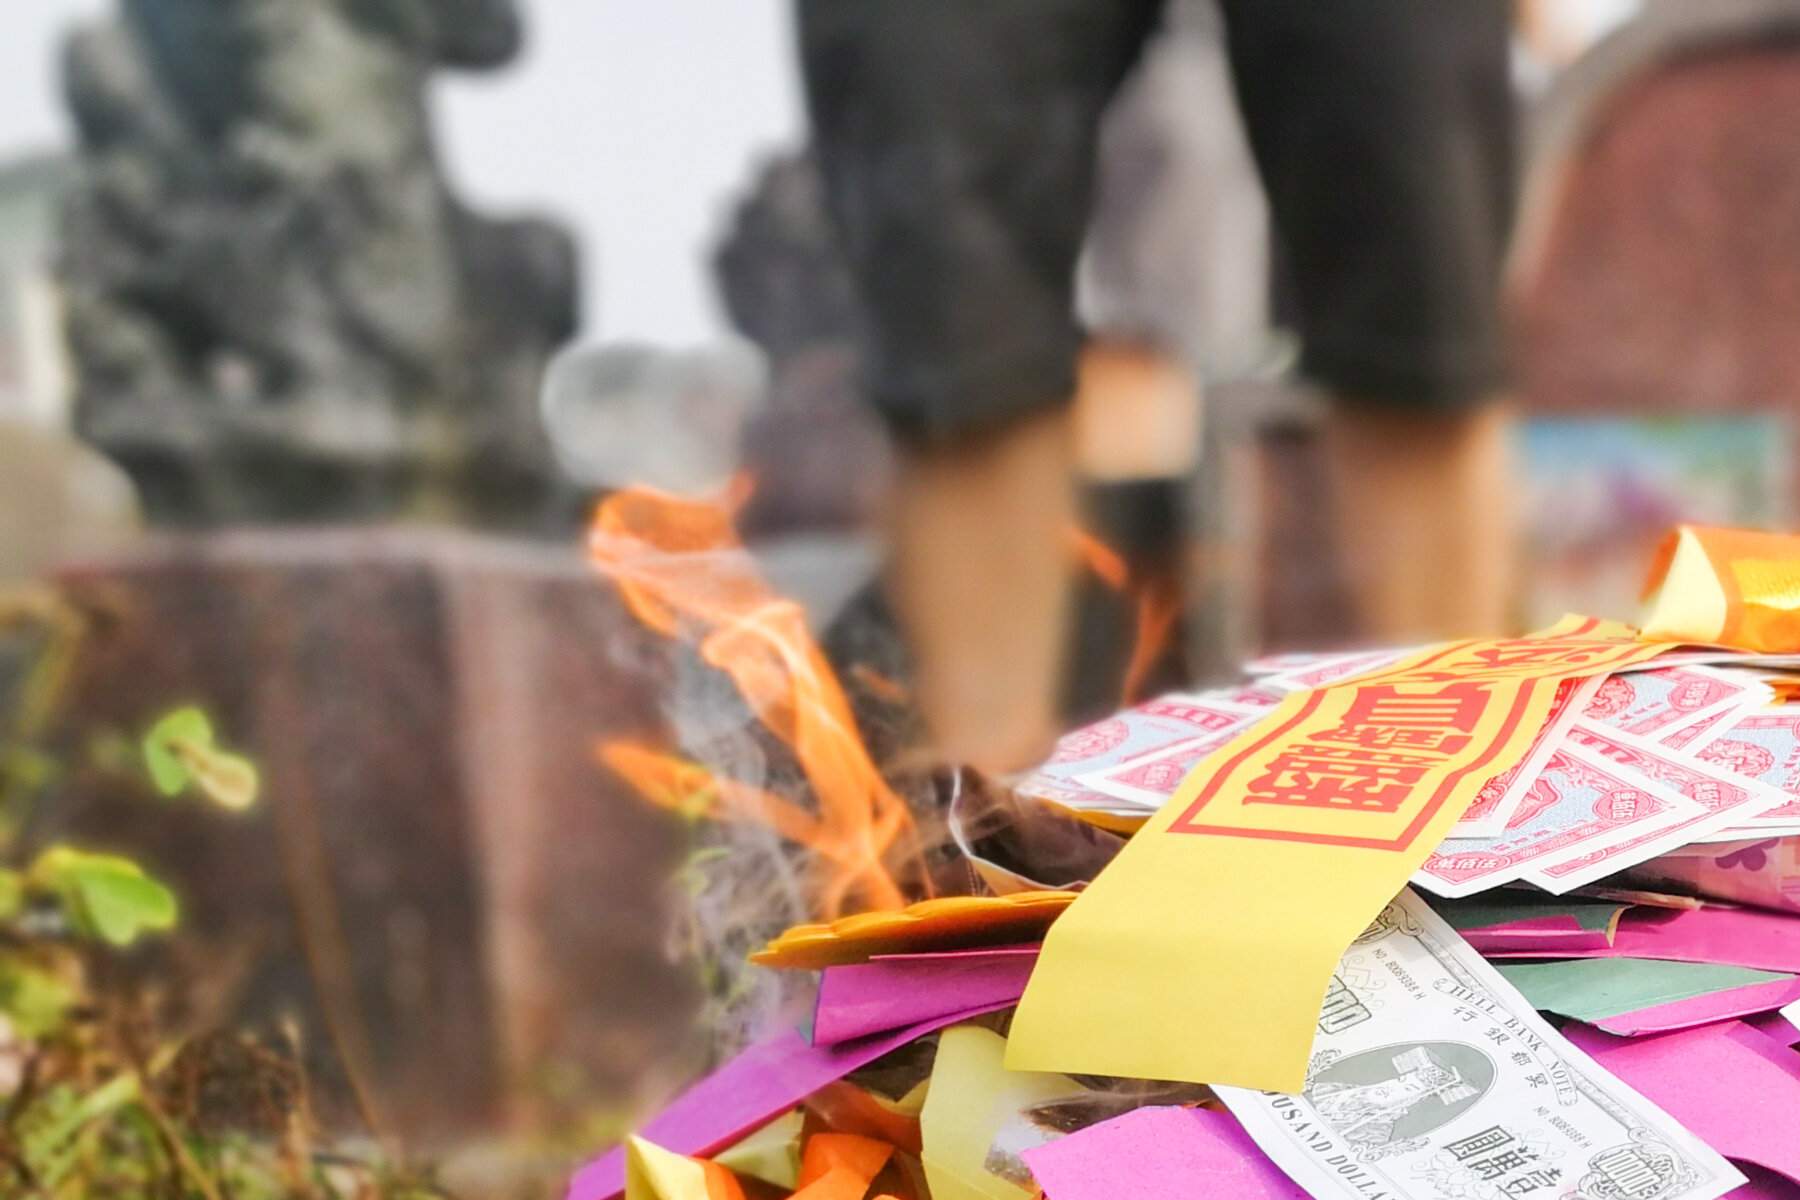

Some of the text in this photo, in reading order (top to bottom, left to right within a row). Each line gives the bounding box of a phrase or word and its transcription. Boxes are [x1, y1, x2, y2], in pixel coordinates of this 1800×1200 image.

[1446, 985, 1573, 1099] HELL BANK NOTE
